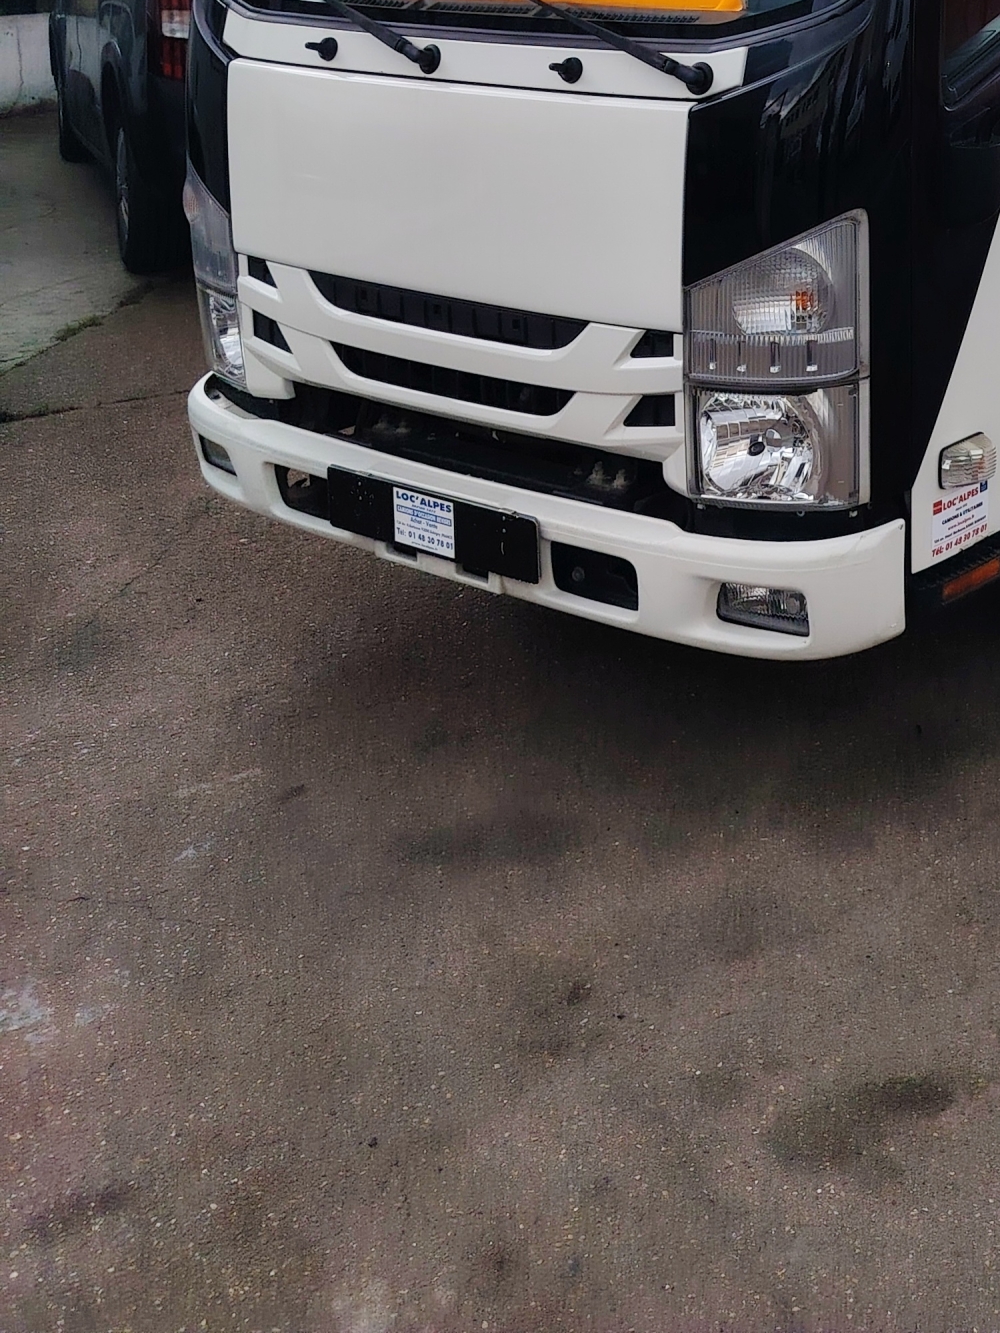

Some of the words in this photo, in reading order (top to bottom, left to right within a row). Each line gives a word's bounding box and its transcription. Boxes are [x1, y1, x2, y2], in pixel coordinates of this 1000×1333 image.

[395, 490, 452, 513] LOC'ALPES
[943, 486, 979, 511] LOC'ALPES
[408, 531, 416, 539] 01
[418, 534, 426, 542] 48
[436, 539, 445, 548] 78
[445, 542, 453, 550] 01
[945, 541, 953, 551] 01
[980, 523, 988, 533] 01
